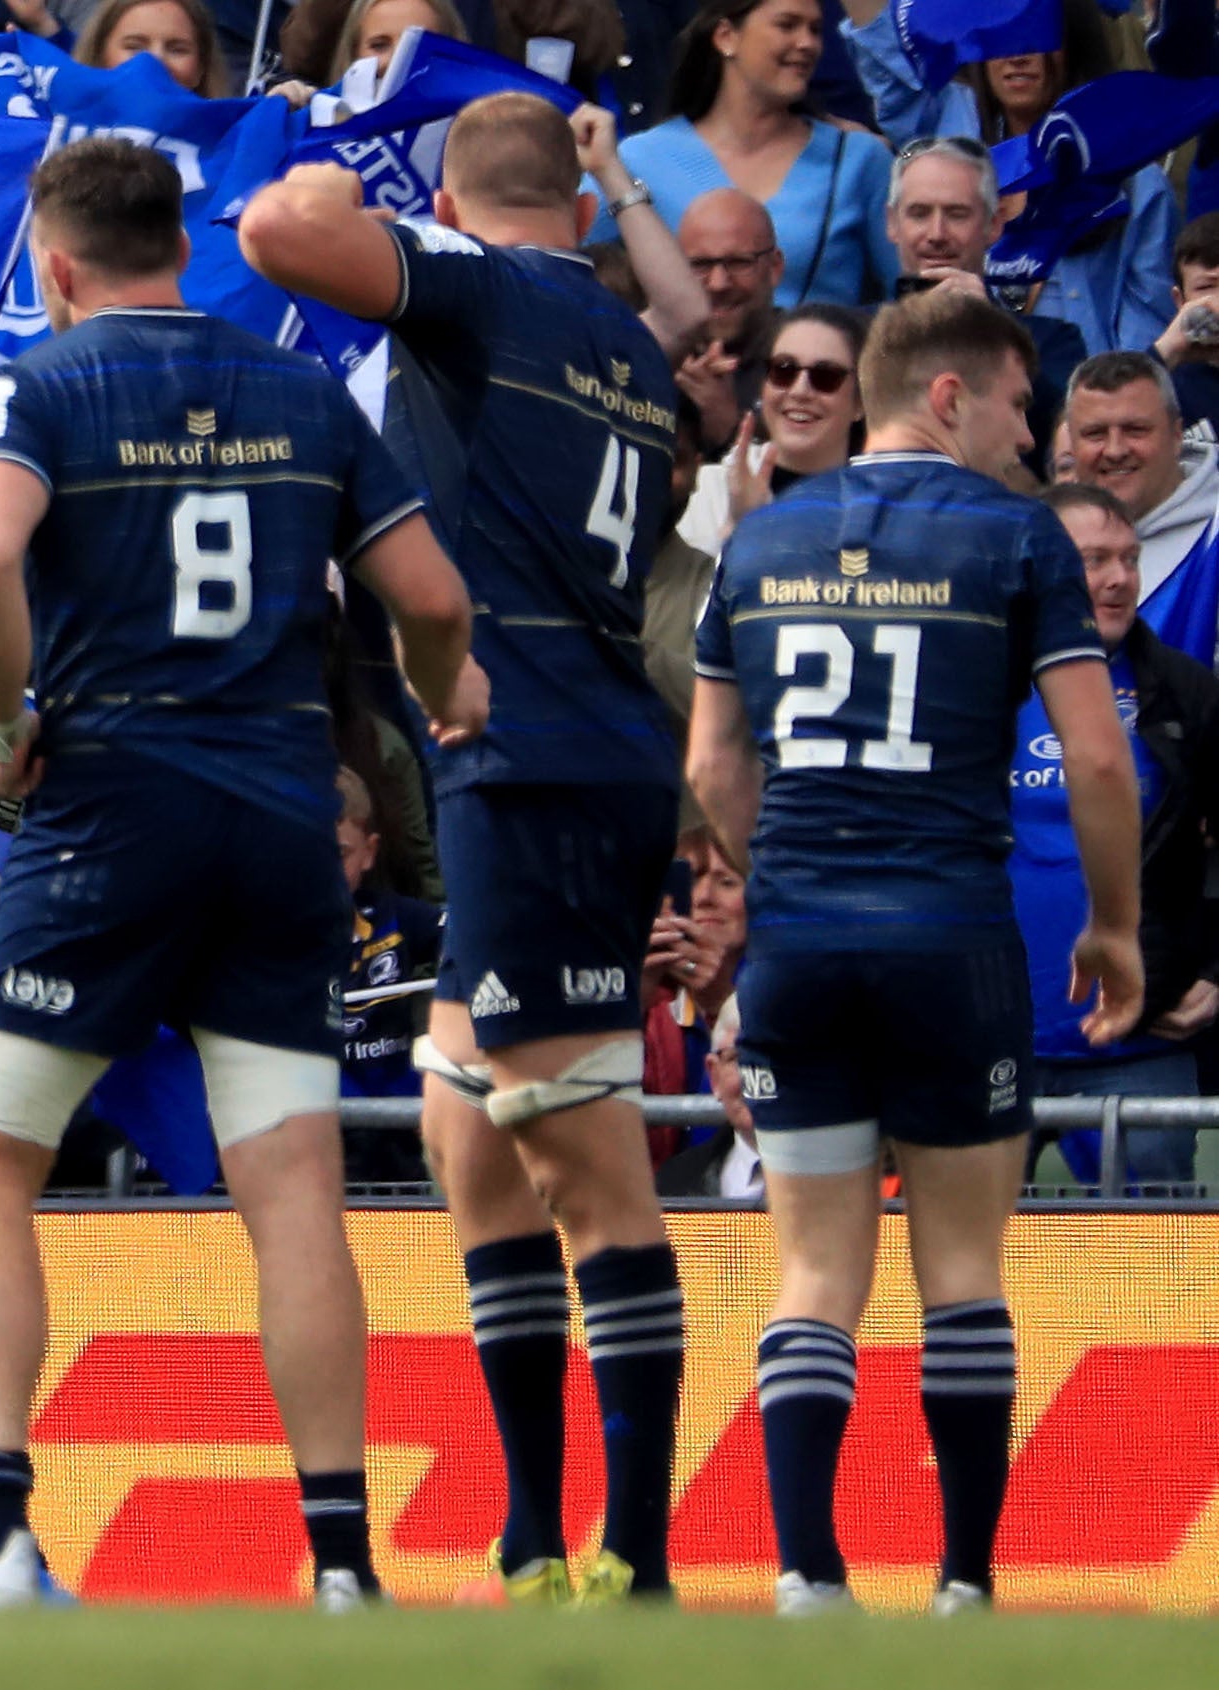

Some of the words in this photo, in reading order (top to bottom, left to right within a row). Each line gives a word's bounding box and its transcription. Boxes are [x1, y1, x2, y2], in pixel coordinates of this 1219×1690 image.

[118, 438, 177, 466] Bank
[180, 441, 205, 464] of
[586, 432, 641, 590] 4
[171, 491, 253, 638] 8
[760, 576, 822, 604] Bank
[823, 579, 855, 605] of
[855, 578, 951, 606] Ireland
[773, 623, 934, 773] 21
